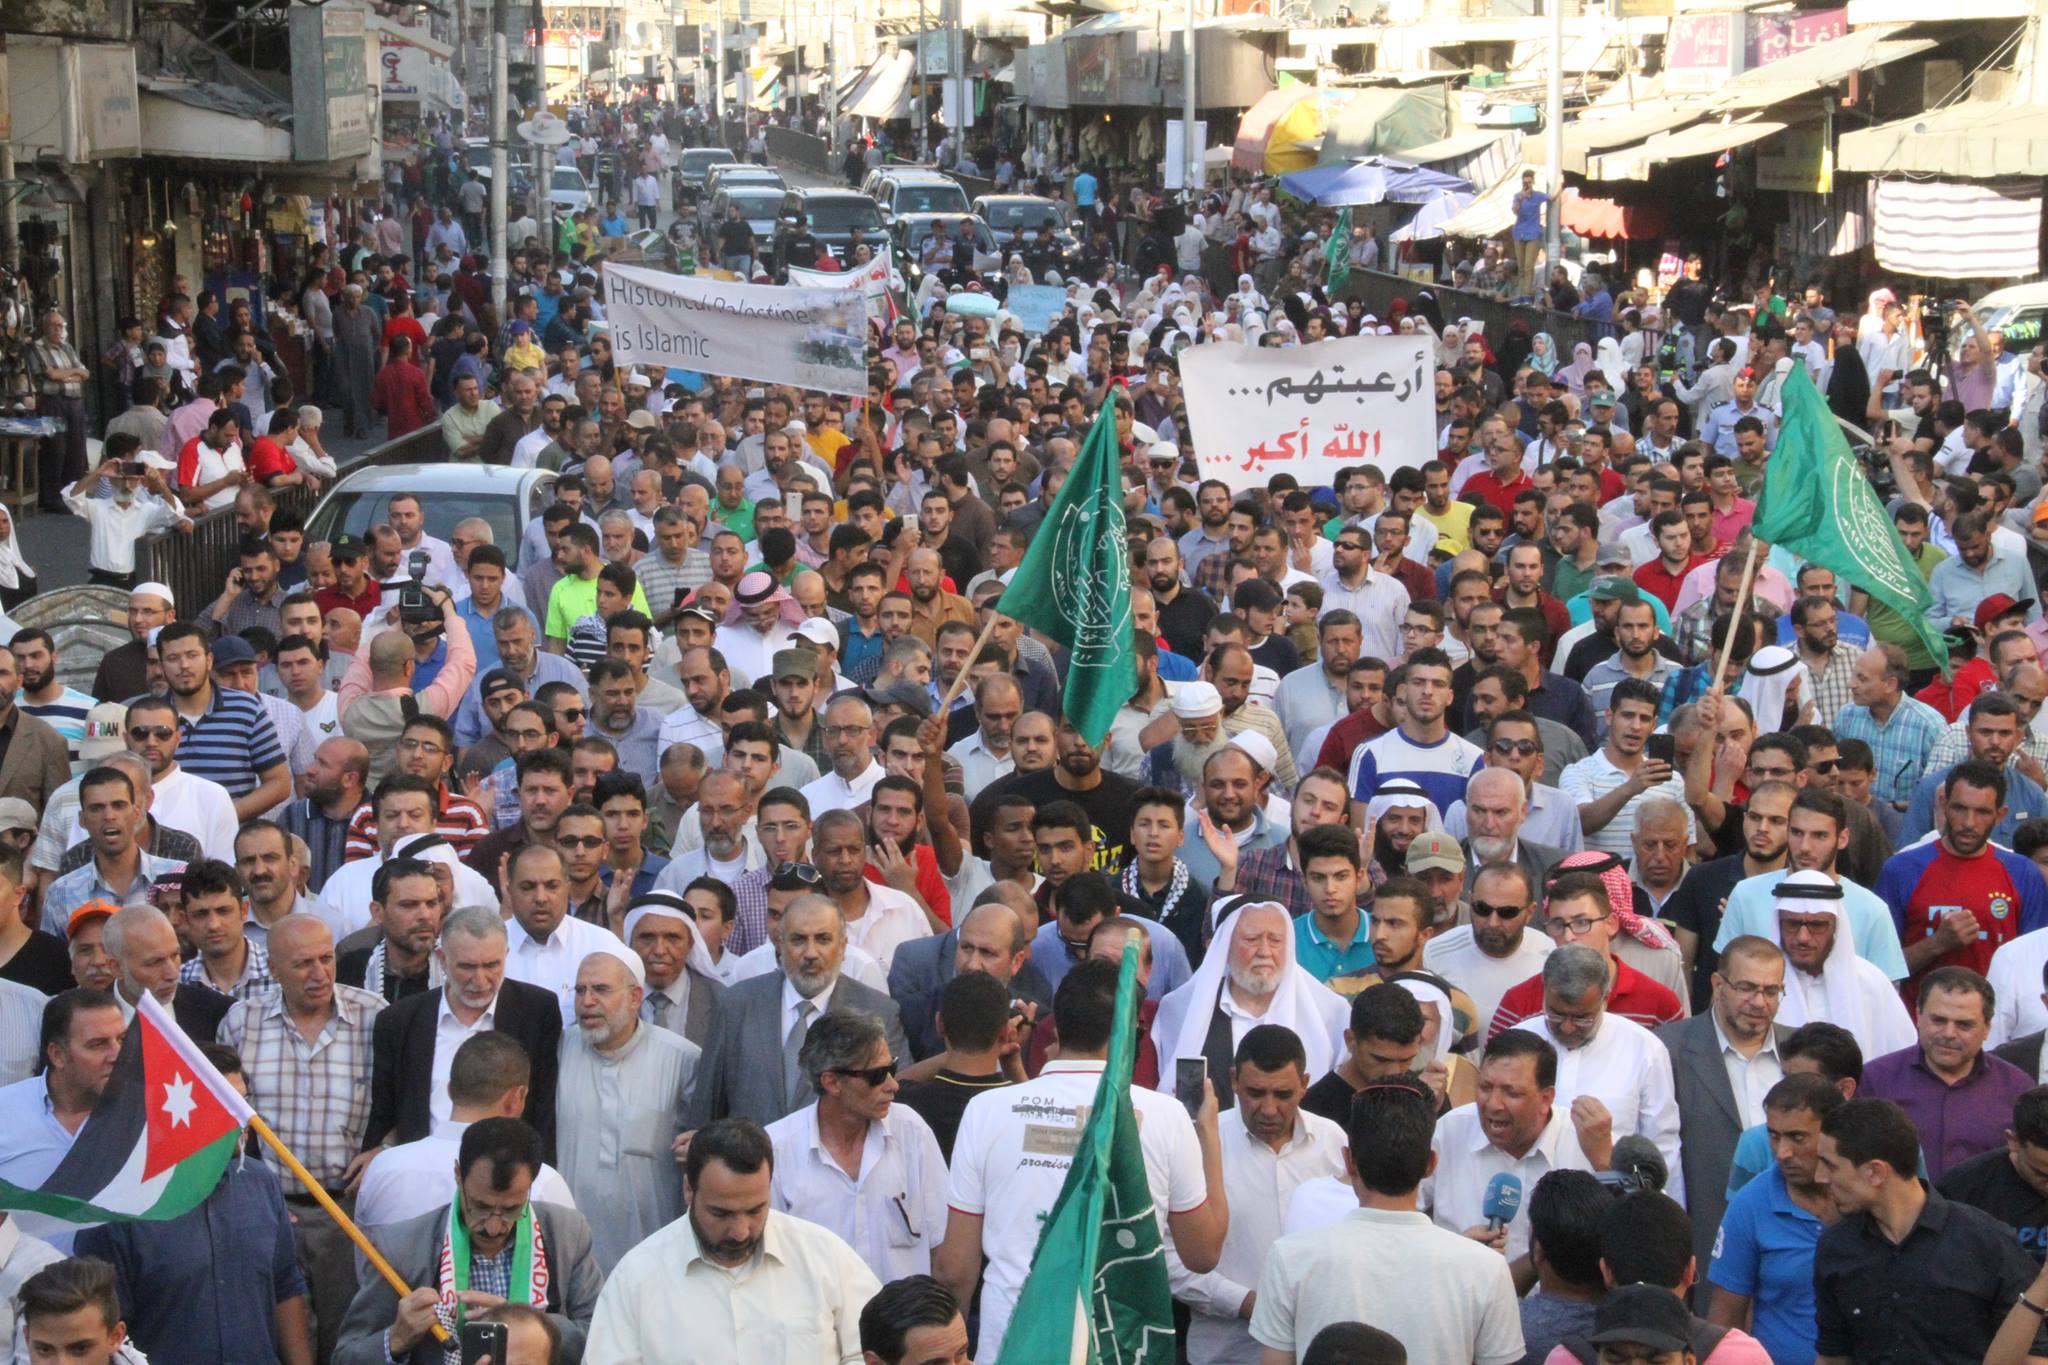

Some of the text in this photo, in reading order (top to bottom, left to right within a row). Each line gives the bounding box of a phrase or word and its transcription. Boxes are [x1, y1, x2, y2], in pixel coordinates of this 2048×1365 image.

[610, 277, 711, 312] Historical
[615, 323, 710, 358] is Islamic
